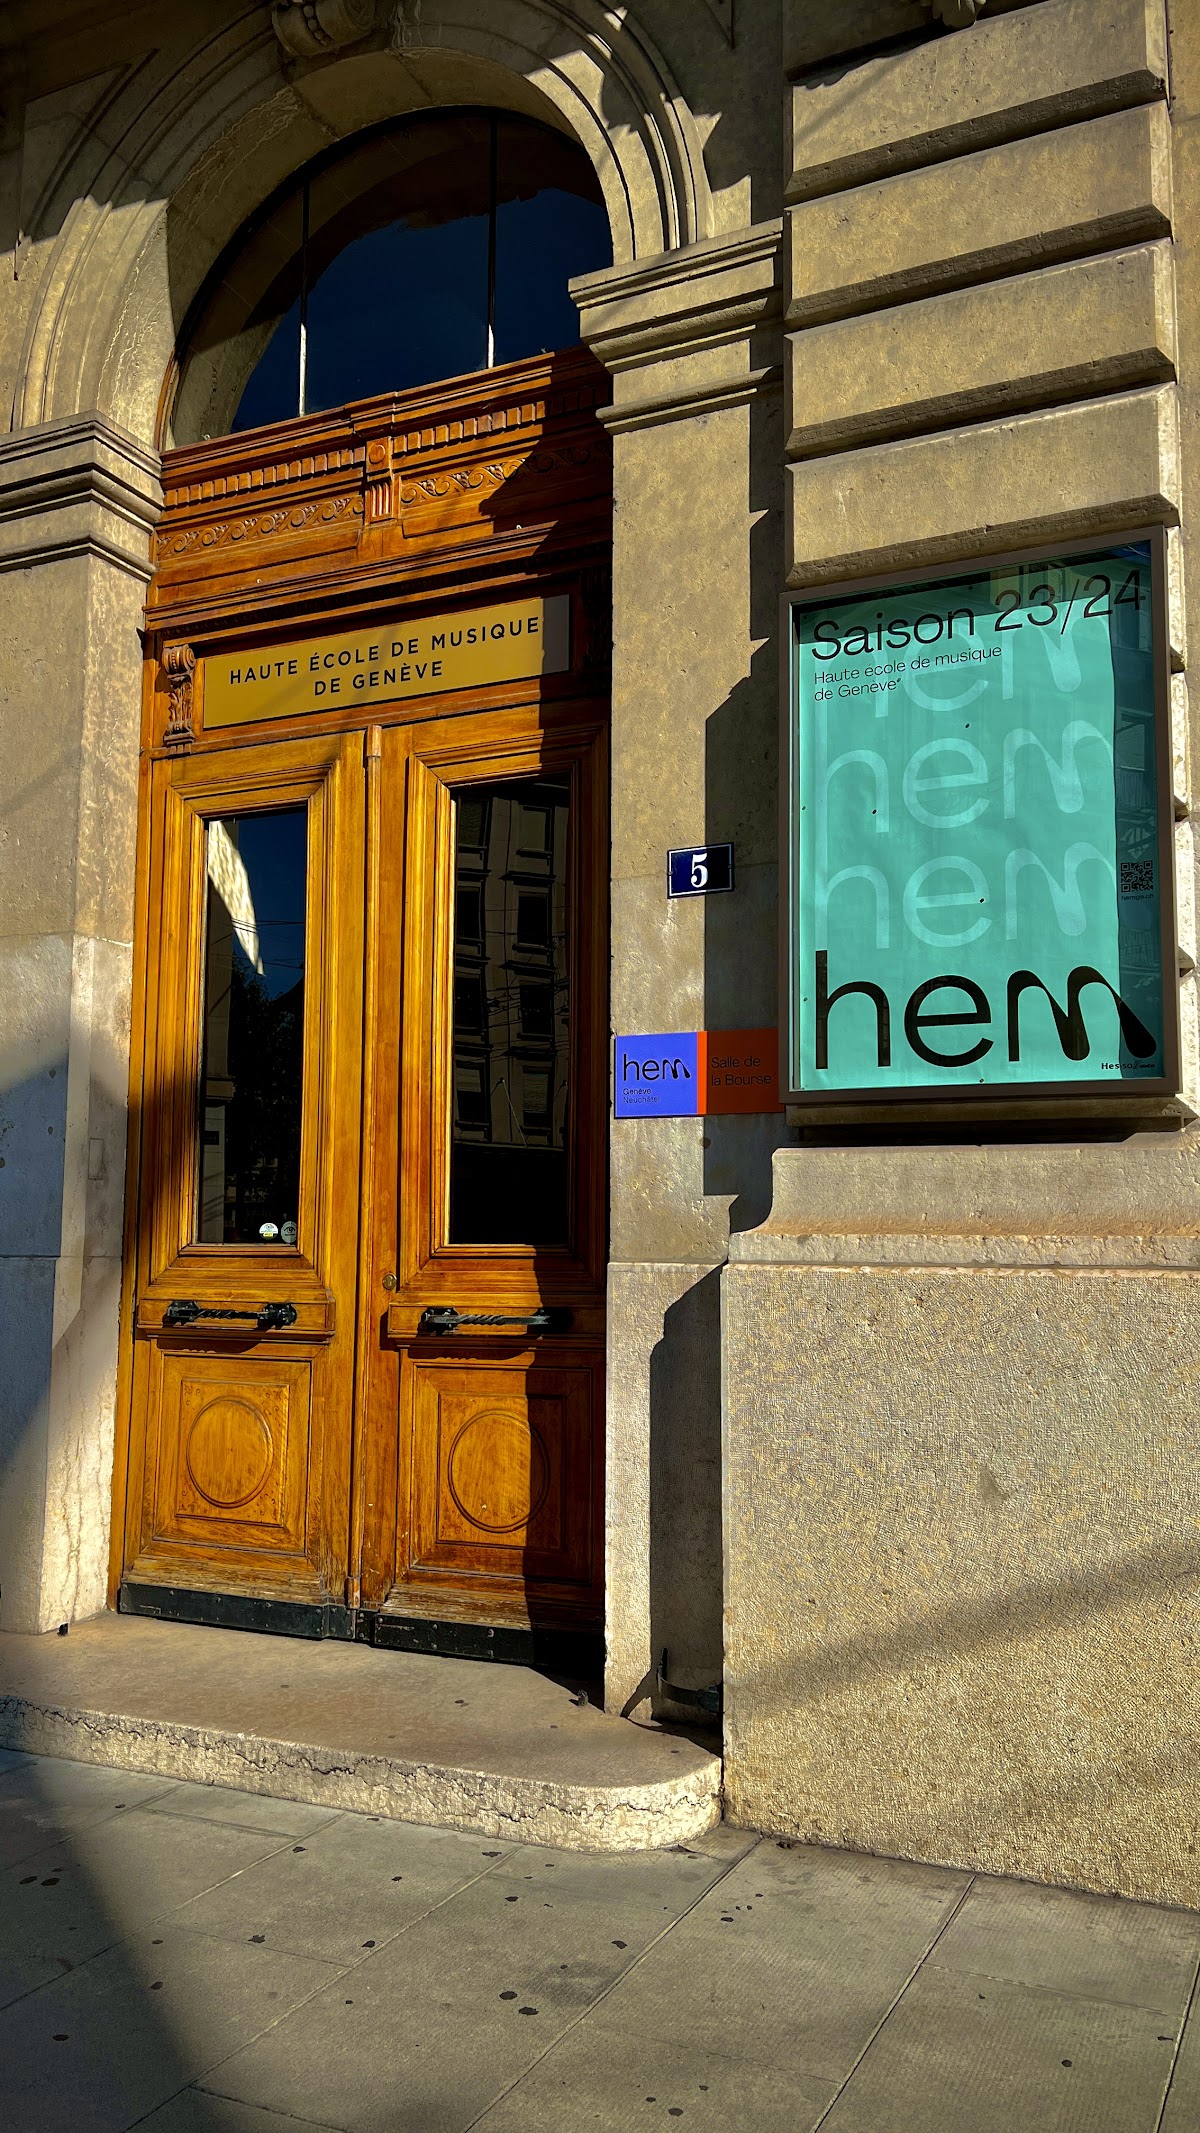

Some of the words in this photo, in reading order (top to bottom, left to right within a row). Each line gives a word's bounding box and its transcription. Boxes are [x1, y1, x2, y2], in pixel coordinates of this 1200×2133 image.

[811, 604, 975, 661] Saison
[994, 569, 1147, 635] 23/24
[229, 659, 299, 685] HAUTE
[309, 645, 380, 672] ÉCOLE
[391, 637, 419, 658] DE
[431, 616, 540, 651] MUSIQUE
[814, 668, 860, 685] Haute
[864, 660, 906, 677] école
[911, 655, 931, 670] de
[935, 646, 1002, 667] musique
[314, 677, 341, 696] DE
[352, 660, 443, 690] GENÈVE
[814, 687, 834, 702] de
[838, 680, 897, 699] Genève
[815, 717, 1115, 835] hem
[690, 852, 708, 888] 5
[815, 833, 1118, 949] hem
[815, 949, 1157, 1070] hem
[623, 1053, 691, 1082] hem
[711, 1056, 740, 1069] Salle
[743, 1056, 761, 1067] de
[711, 1074, 721, 1086] la
[725, 1073, 772, 1086] Bourse
[623, 1087, 652, 1096] Genève
